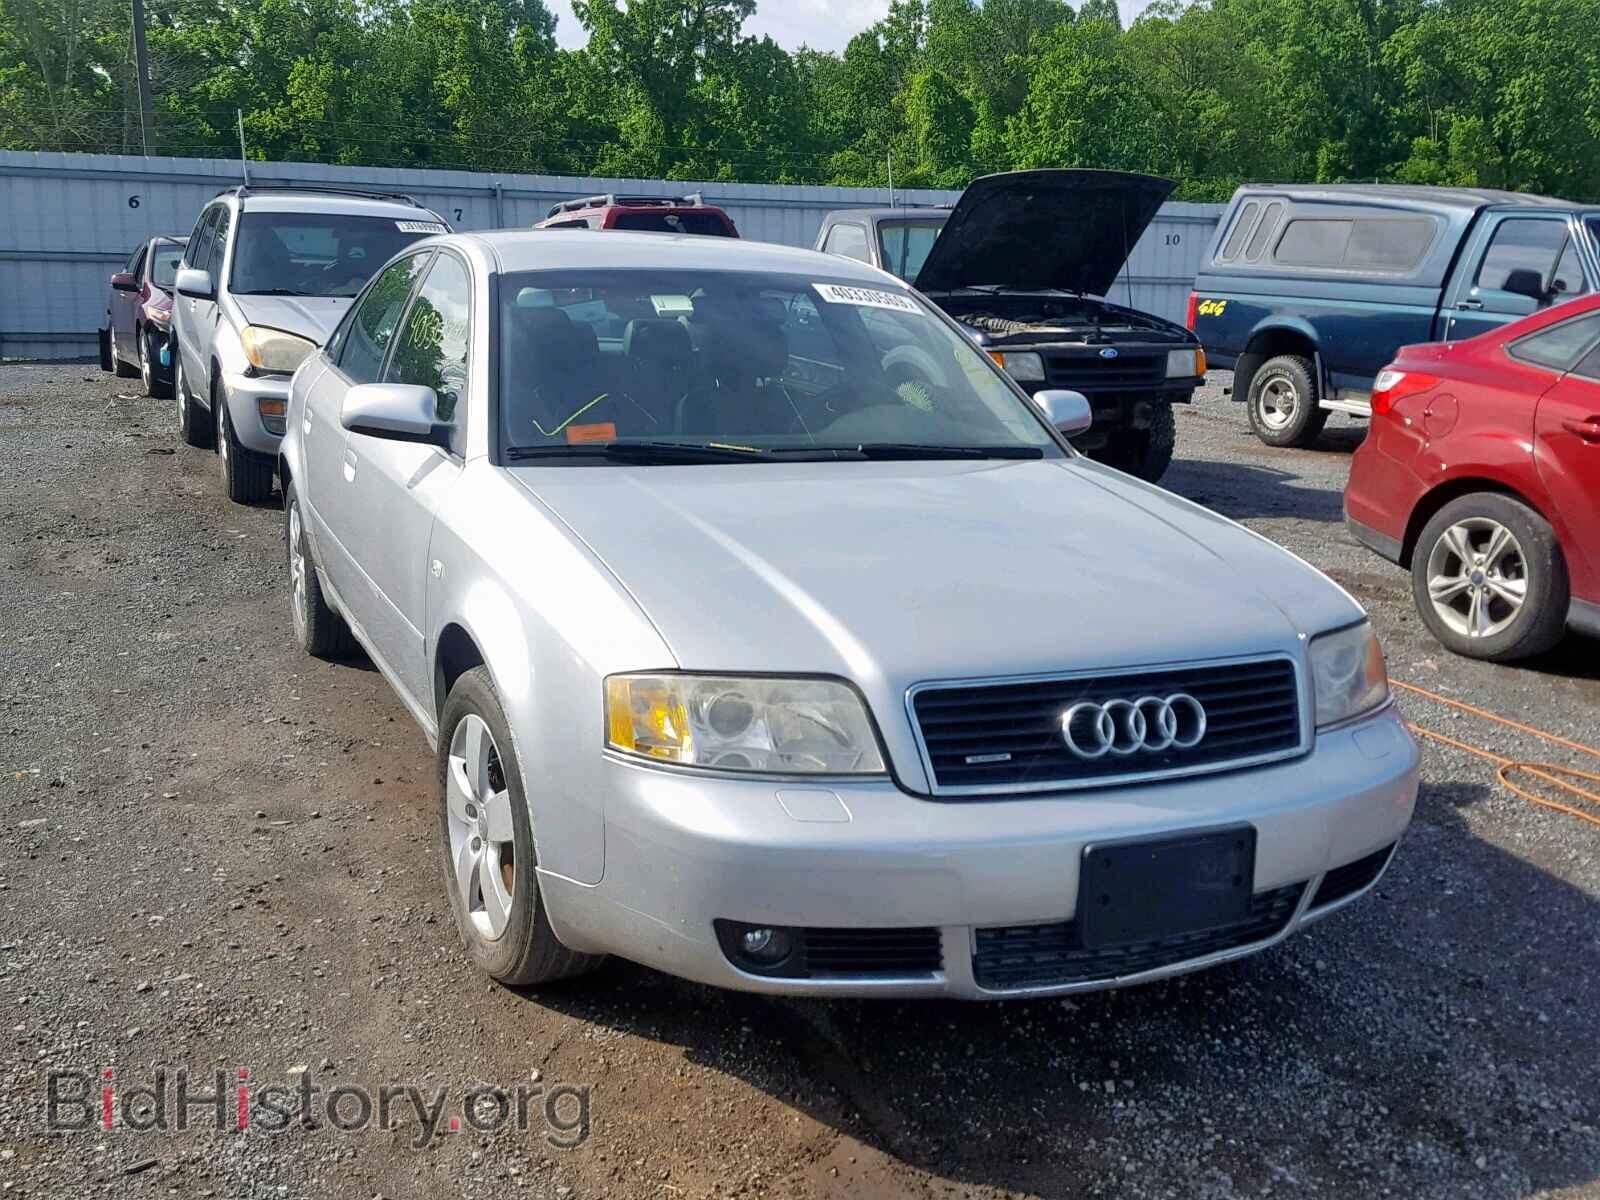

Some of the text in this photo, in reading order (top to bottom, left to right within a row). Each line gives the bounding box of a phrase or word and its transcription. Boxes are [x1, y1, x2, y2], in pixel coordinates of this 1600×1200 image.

[128, 195, 140, 209] 6
[454, 208, 463, 222] 7
[1165, 234, 1181, 246] 10
